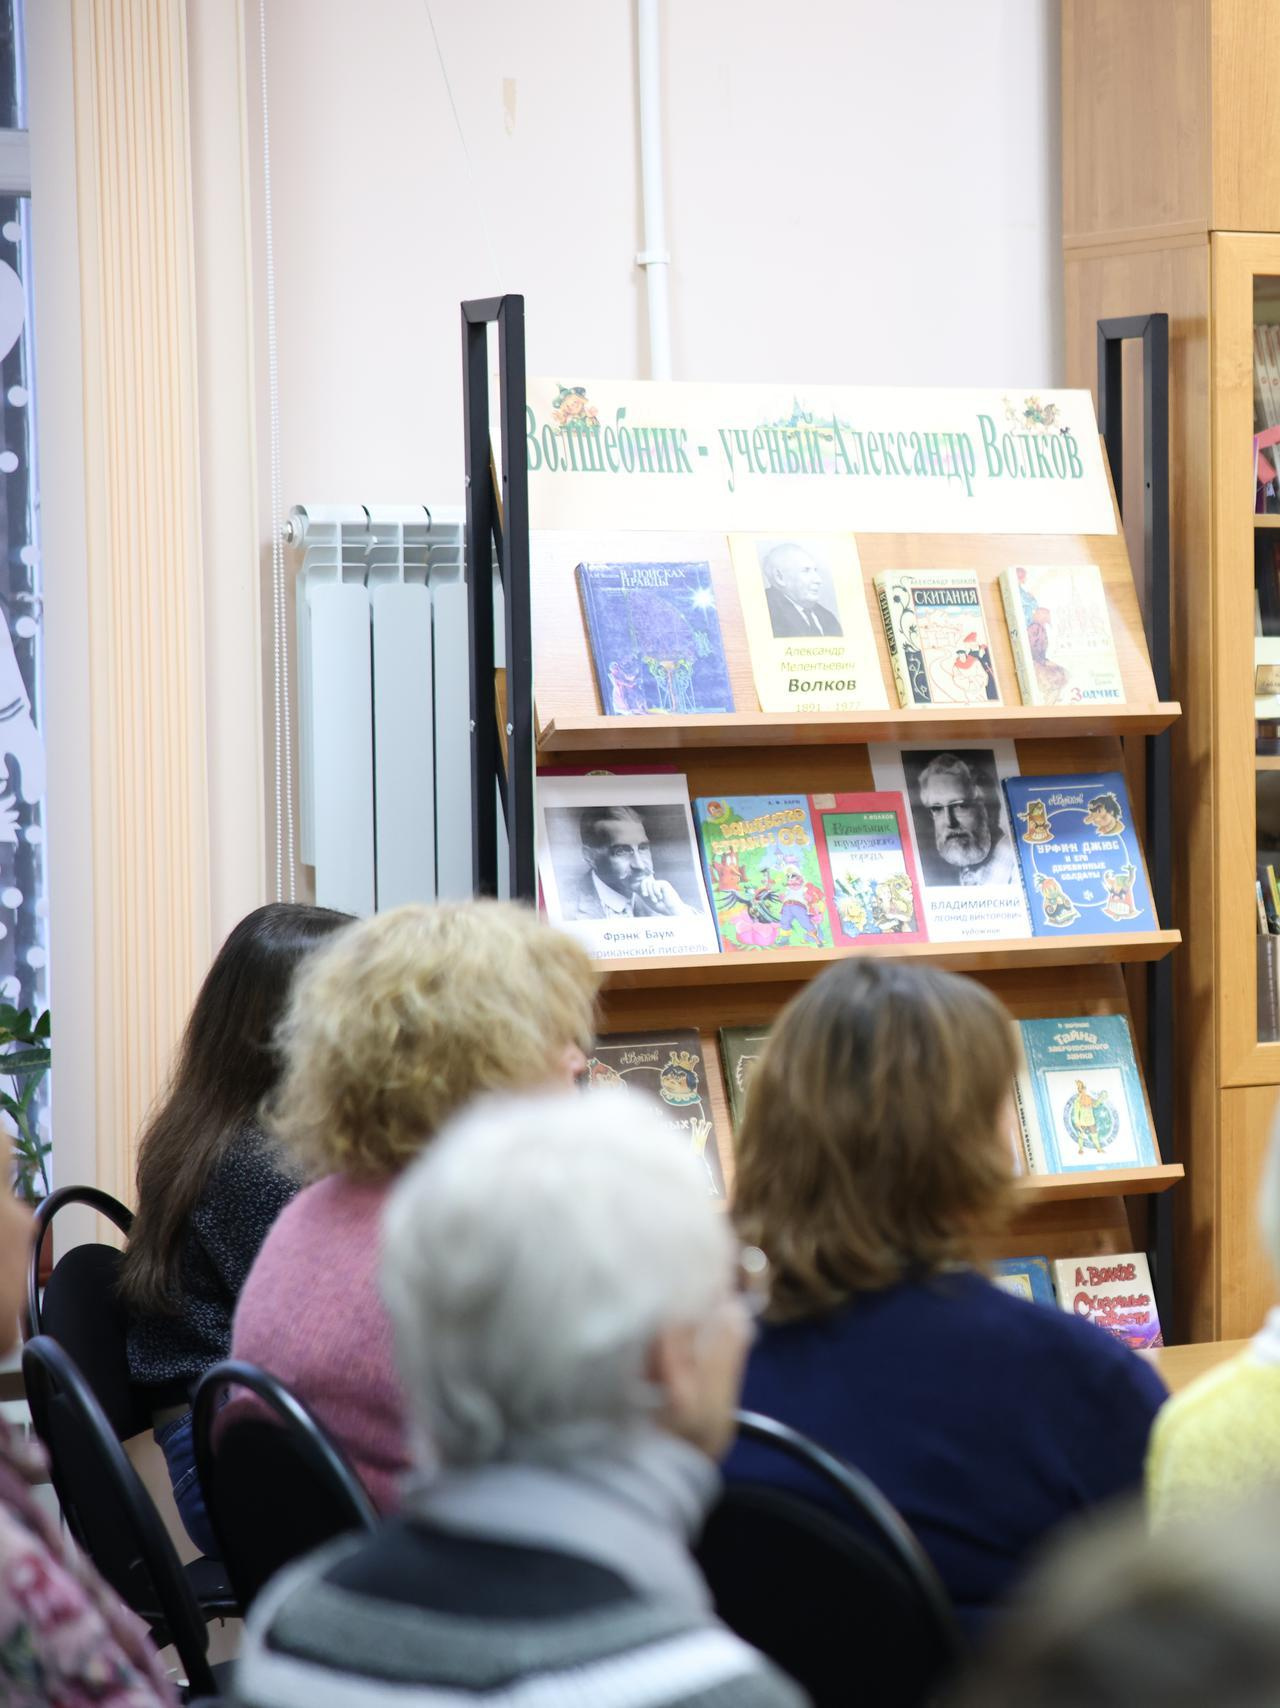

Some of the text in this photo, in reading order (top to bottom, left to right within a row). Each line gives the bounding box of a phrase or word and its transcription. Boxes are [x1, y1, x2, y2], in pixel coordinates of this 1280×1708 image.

[526, 404, 693, 474] Волшебник
[718, 411, 827, 494] ученый
[832, 411, 977, 498] Александр
[976, 414, 1085, 480] Волков
[634, 567, 686, 579] ПОИСКАХ
[621, 577, 670, 588] ПРАВДЫ
[914, 589, 978, 605] СКИТАНИЯ
[879, 591, 898, 656] СКИТАНИЯ
[784, 646, 846, 657] Александр
[788, 678, 857, 693] Волков
[1070, 687, 1120, 702] Зодчие
[1036, 840, 1120, 855] УРФИН ДЖЮС
[1052, 862, 1107, 874] ДЕРЕВЯННЫЕ
[1061, 871, 1101, 881] СОЛДАТЫ
[931, 898, 1021, 911] ВЛАДИМИРСКИЙ
[934, 914, 968, 922] ЛЕОНИД
[603, 929, 675, 943] Фрэнк Баум
[658, 943, 709, 956] писатель
